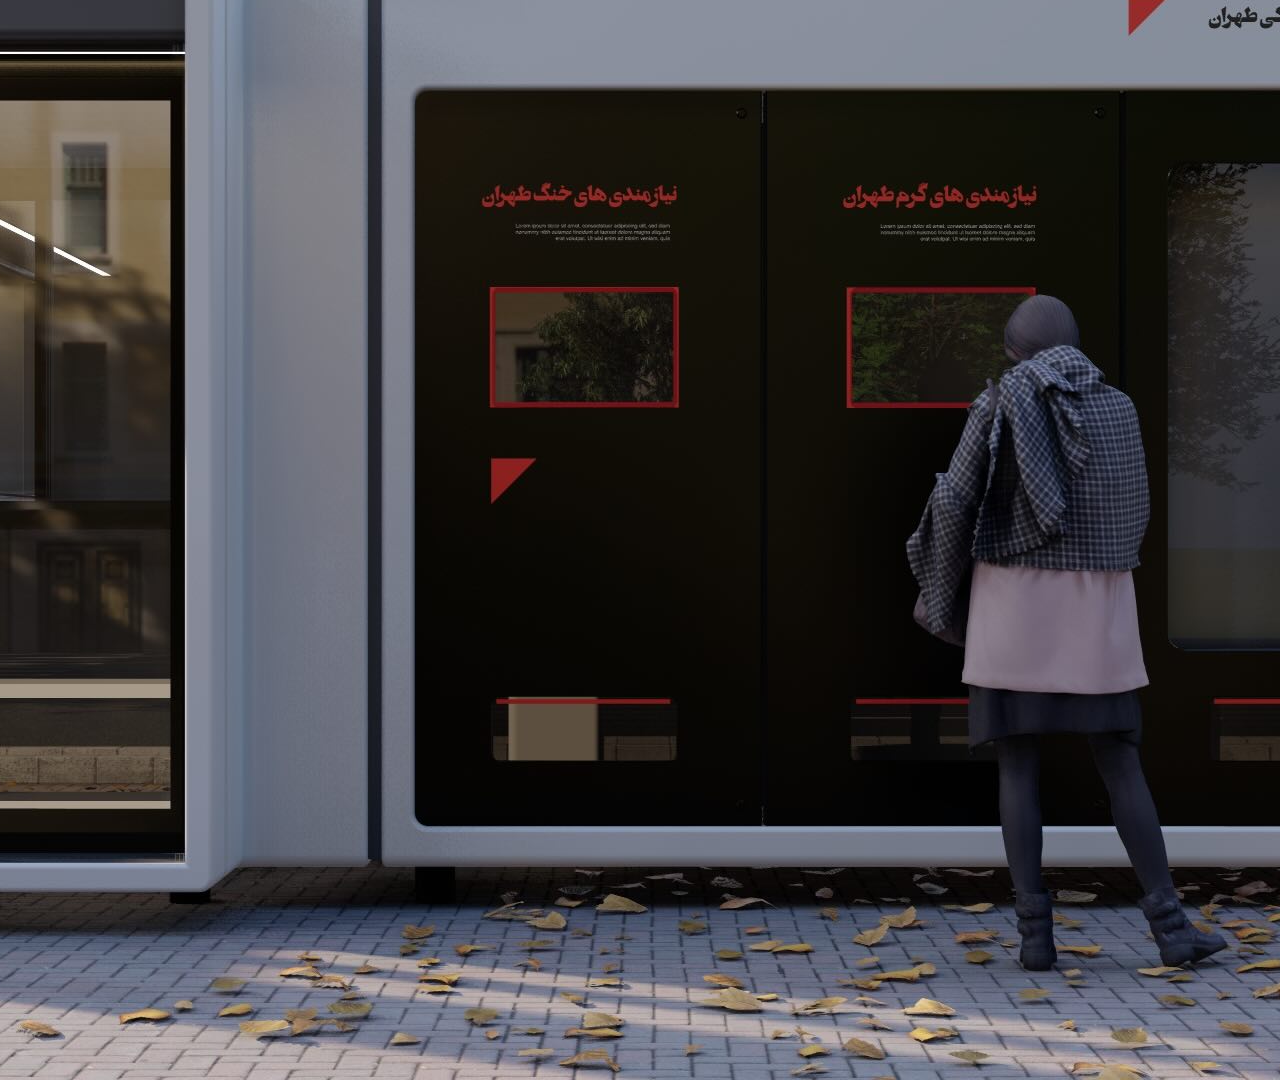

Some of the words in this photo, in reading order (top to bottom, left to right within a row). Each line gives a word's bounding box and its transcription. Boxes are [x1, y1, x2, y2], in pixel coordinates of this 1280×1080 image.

[1208, 6, 1258, 29] طهران
[481, 185, 532, 208] طهران
[573, 185, 607, 208] های
[842, 185, 895, 209] طهران
[895, 182, 929, 209] گرم
[929, 185, 964, 209] های
